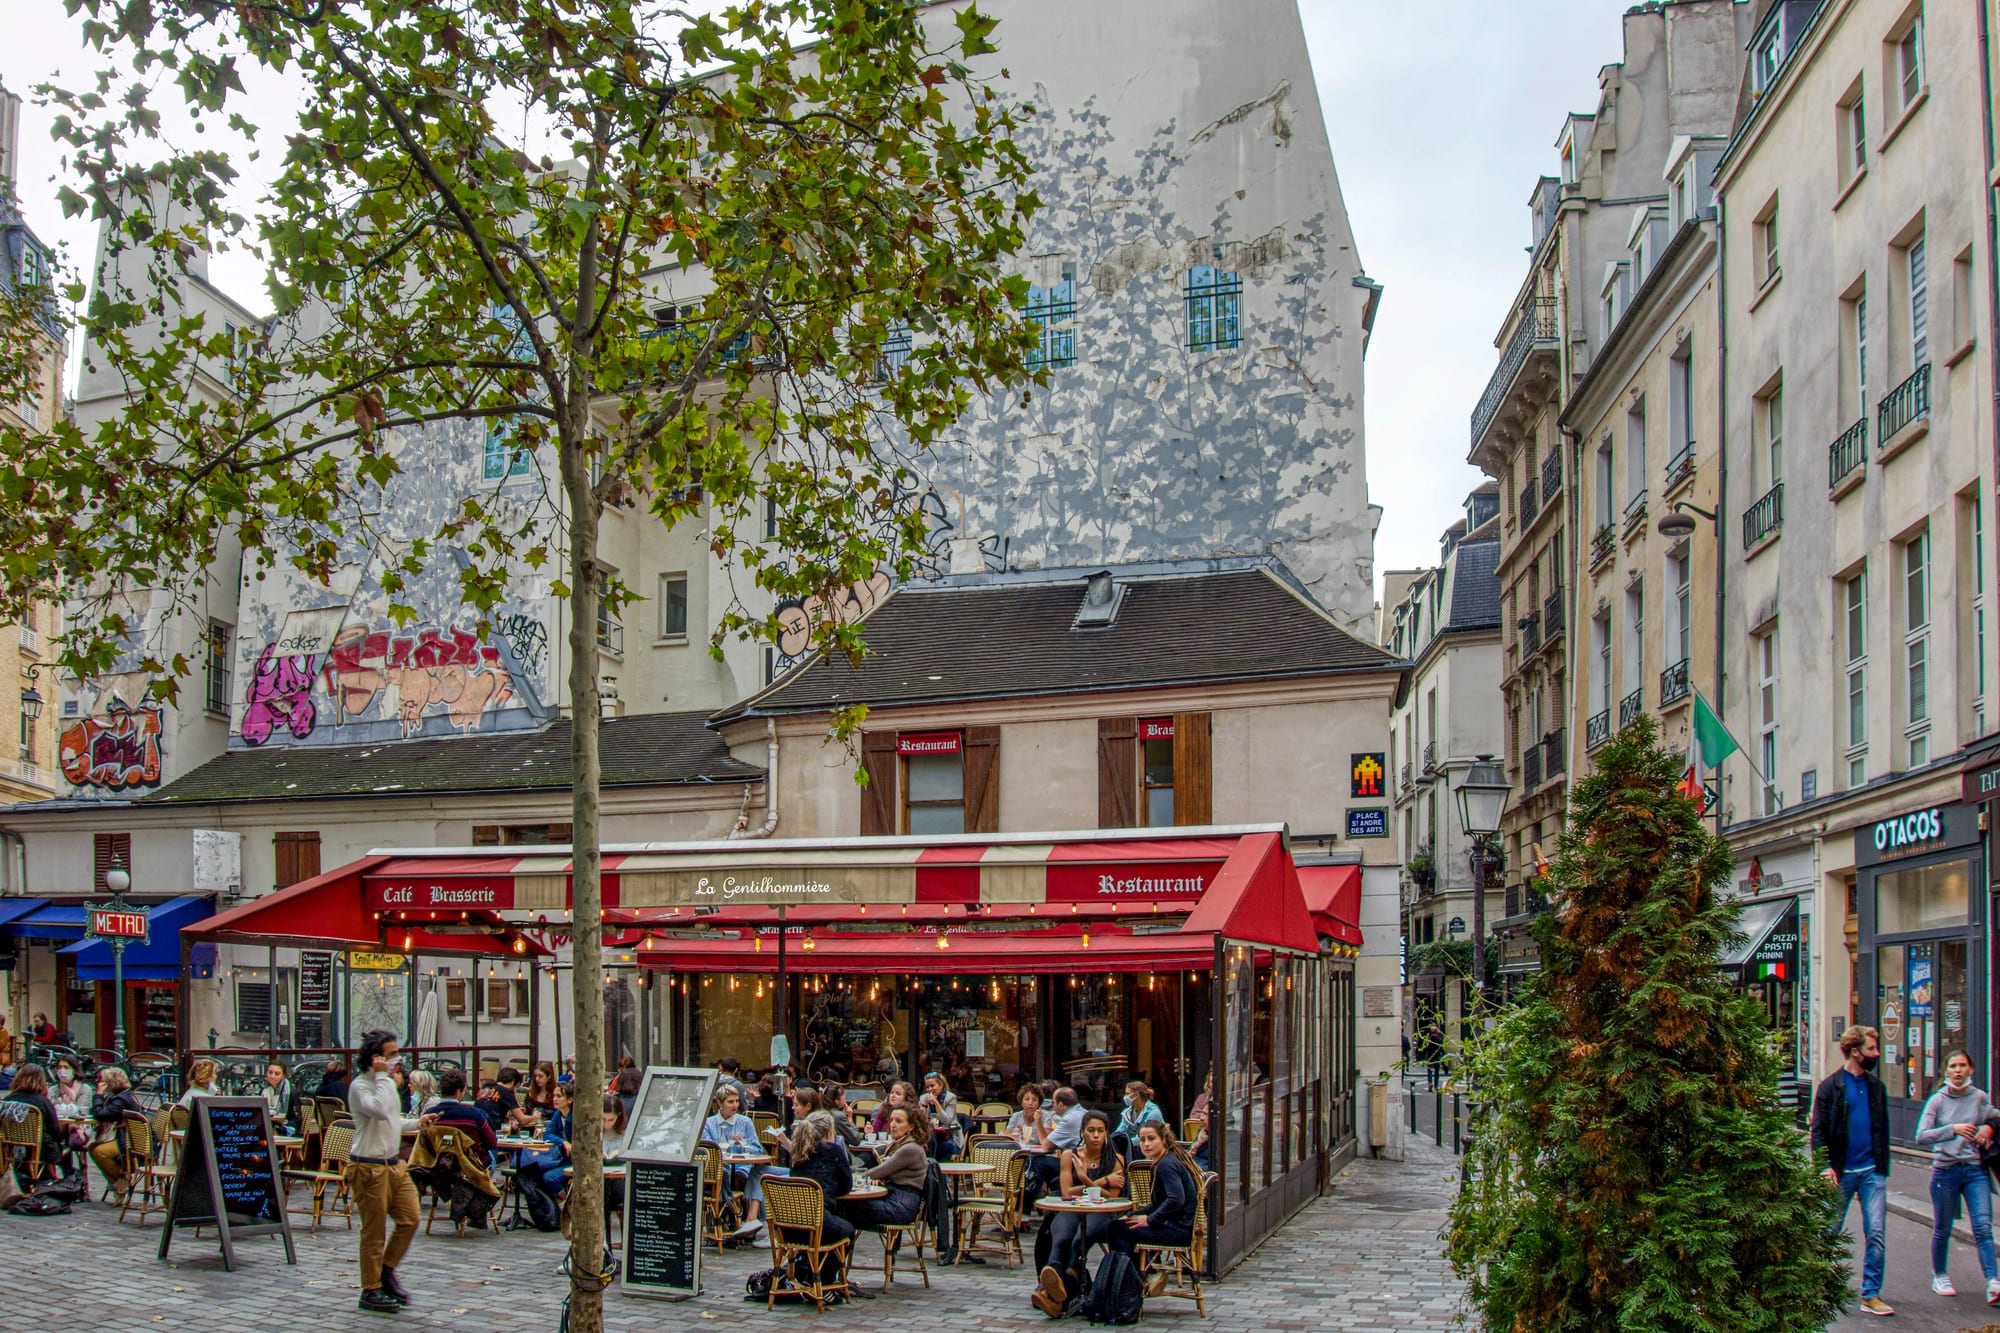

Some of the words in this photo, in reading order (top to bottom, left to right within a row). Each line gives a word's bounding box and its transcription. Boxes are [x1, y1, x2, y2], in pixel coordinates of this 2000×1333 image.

[901, 739, 957, 751] Restaurant
[1356, 812, 1379, 820] PLACE
[1366, 826, 1384, 834] ARTS
[1873, 808, 1942, 850] O'TACOS
[695, 878, 716, 895] La
[723, 877, 831, 899] Gentilhommière
[1098, 875, 1204, 894] Restaurant
[383, 886, 413, 903] Café
[430, 886, 495, 904] Brasserie
[96, 913, 145, 934] METRO
[1773, 934, 1797, 942] PIZZA
[1765, 942, 1793, 951] PASTA
[1757, 951, 1783, 960] PANINI
